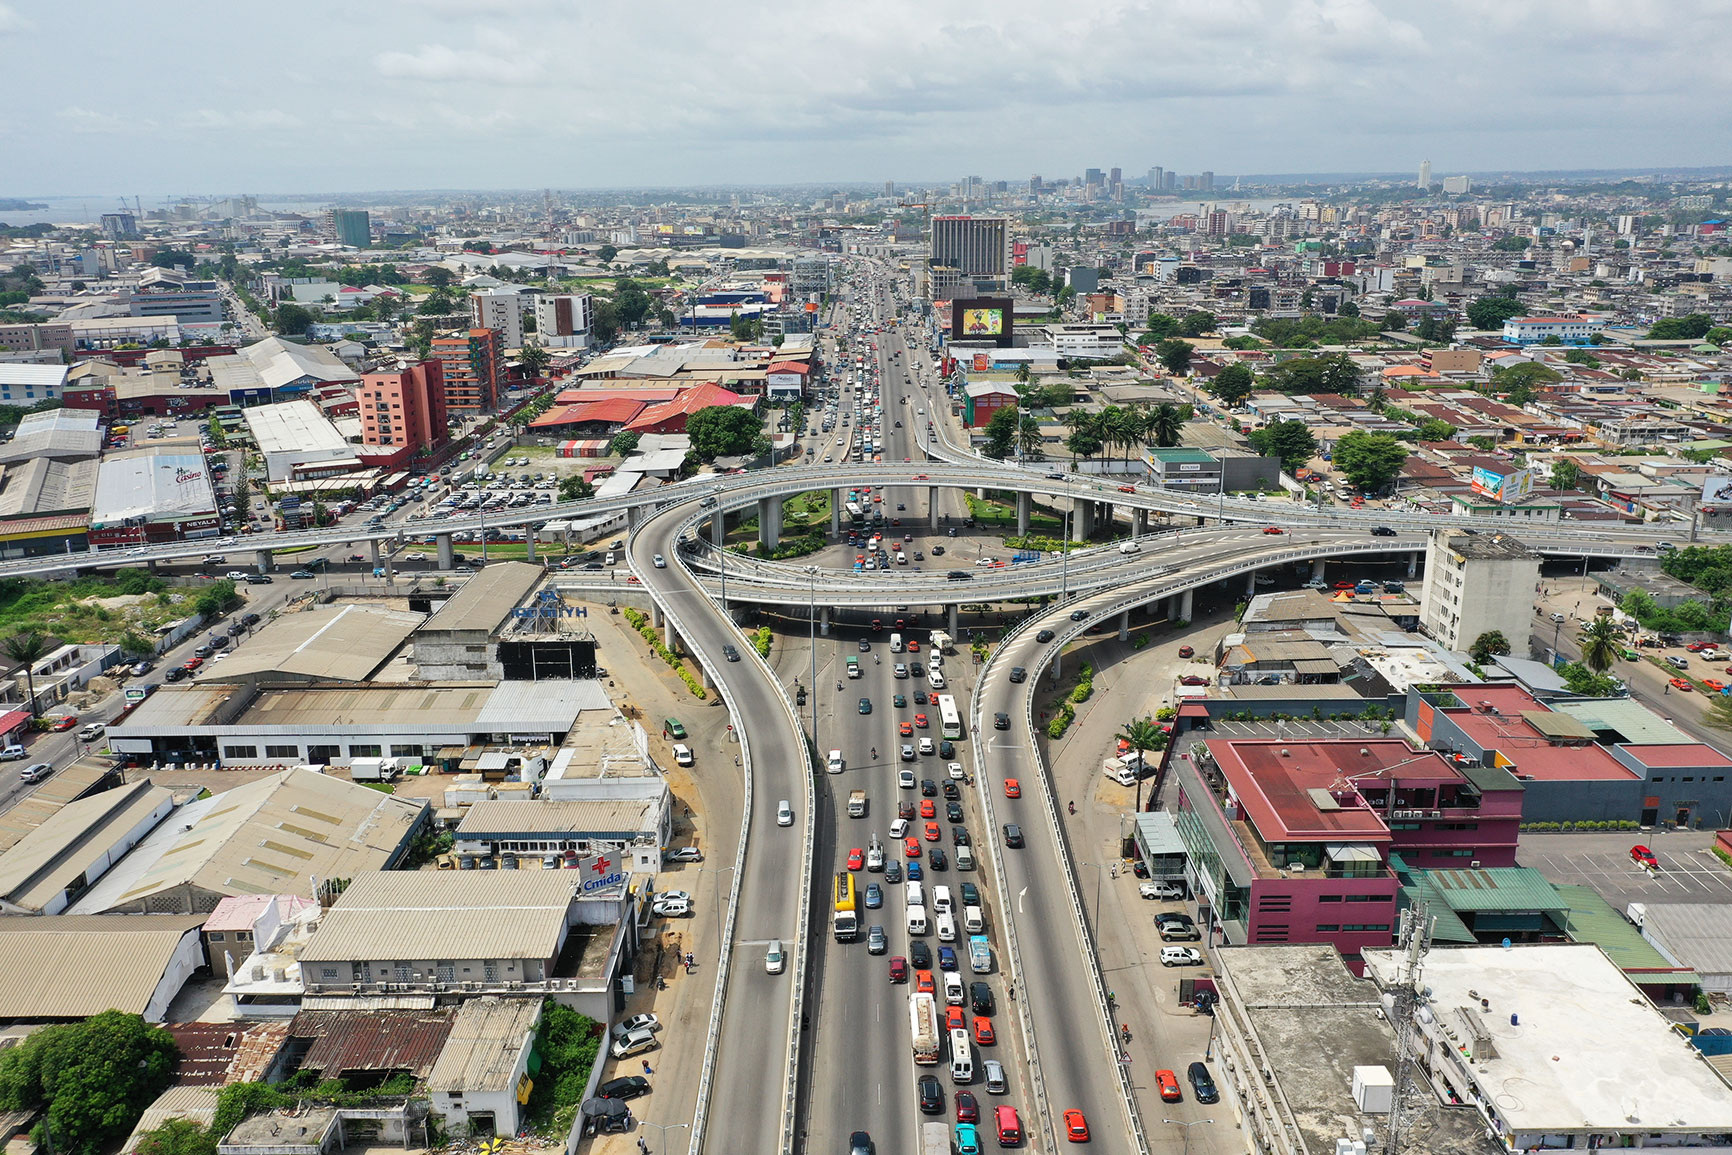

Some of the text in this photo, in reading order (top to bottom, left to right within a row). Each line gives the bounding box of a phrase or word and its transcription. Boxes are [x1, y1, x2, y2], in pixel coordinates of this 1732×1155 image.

[175, 471, 202, 484] Casino
[186, 519, 217, 527] NEYALA
[583, 872, 621, 891] Cmida
